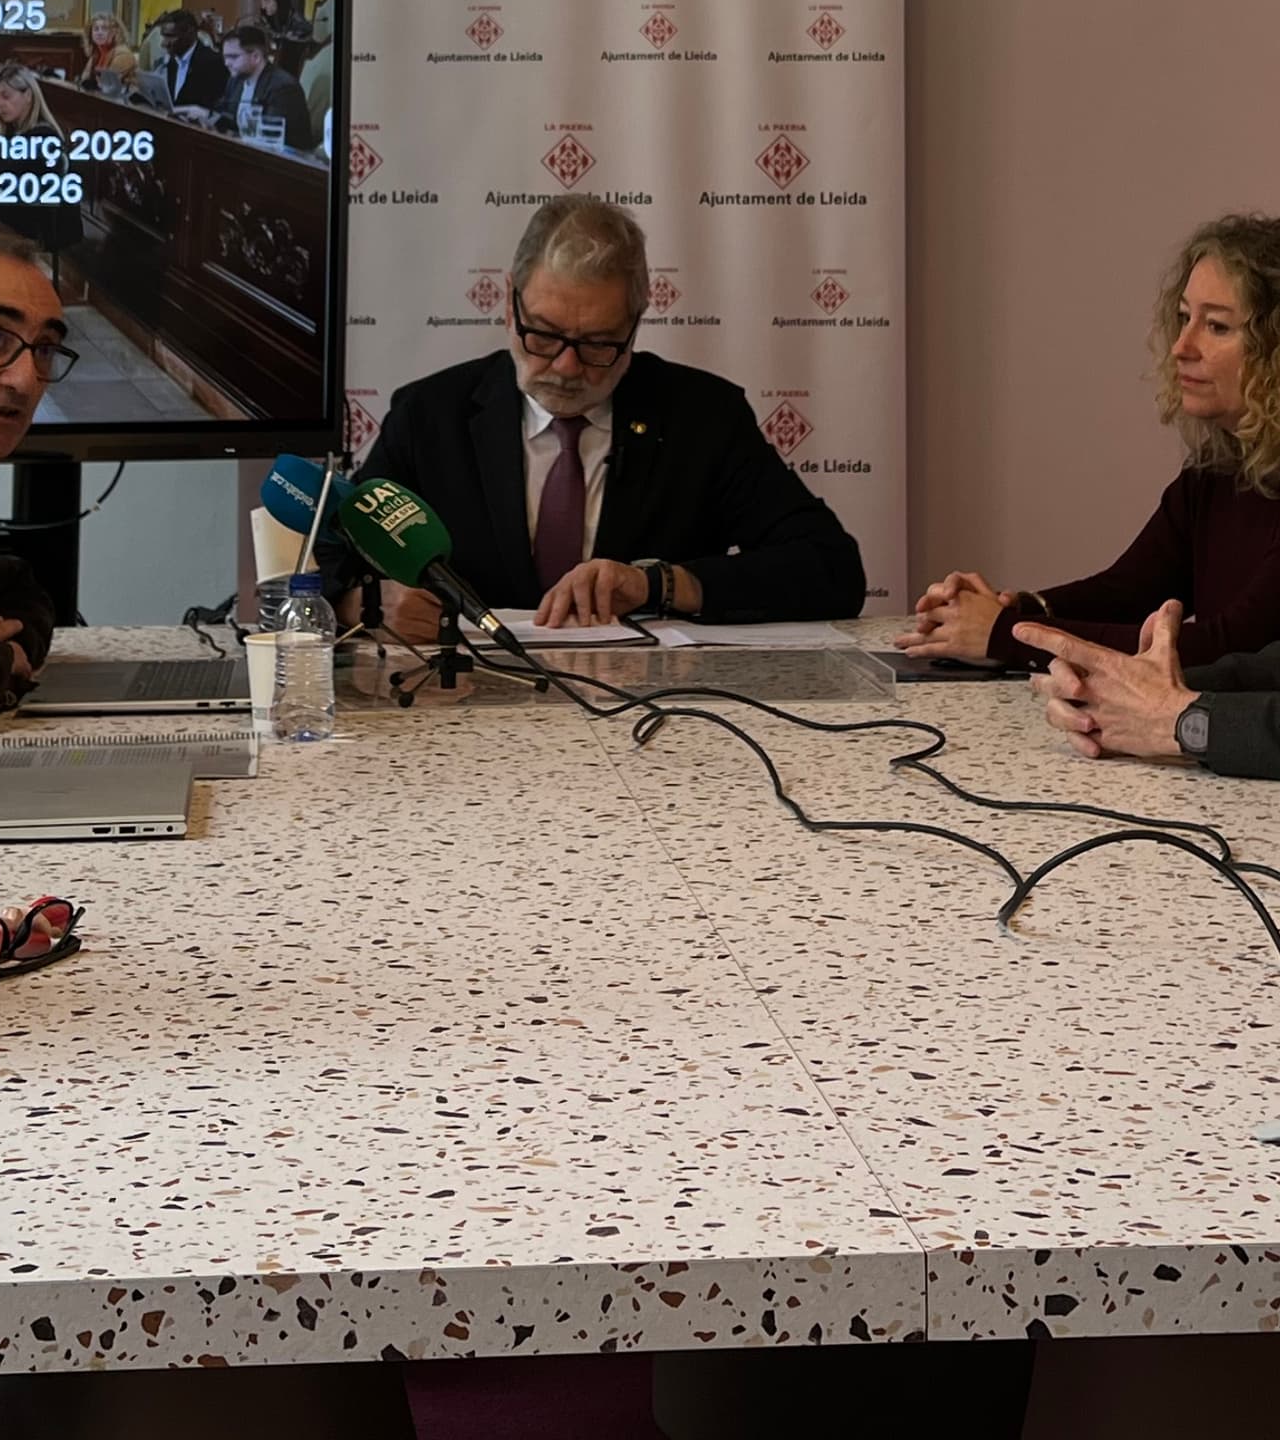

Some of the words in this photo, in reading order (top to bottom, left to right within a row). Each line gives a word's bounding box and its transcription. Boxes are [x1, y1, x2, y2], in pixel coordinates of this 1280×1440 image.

[427, 52, 490, 63] Ajuntament
[493, 52, 507, 62] de
[510, 52, 544, 62] Lleida
[600, 51, 665, 63] Ajuntament
[668, 51, 682, 61] de
[685, 51, 718, 61] Lleida
[767, 52, 832, 63] Ajuntament
[835, 52, 849, 62] de
[852, 52, 886, 62] Lleida
[544, 123, 555, 131] LA
[758, 123, 770, 131] LA
[773, 123, 807, 131] PAERIA
[70, 130, 154, 162] 2026
[368, 190, 388, 205] de
[392, 190, 439, 205] Lleida
[606, 191, 653, 205] Lleida
[699, 191, 792, 208] Ajuntament
[796, 192, 816, 205] de
[820, 192, 868, 205] Lleida
[427, 316, 492, 328] Ajuntament
[671, 316, 685, 326] de
[687, 316, 721, 326] Lleida
[771, 316, 837, 328] Ajuntament
[840, 316, 854, 327] de
[856, 317, 890, 327] Lleida
[800, 460, 818, 473] de
[824, 460, 871, 473] Lleida
[369, 496, 411, 524] Lleida
